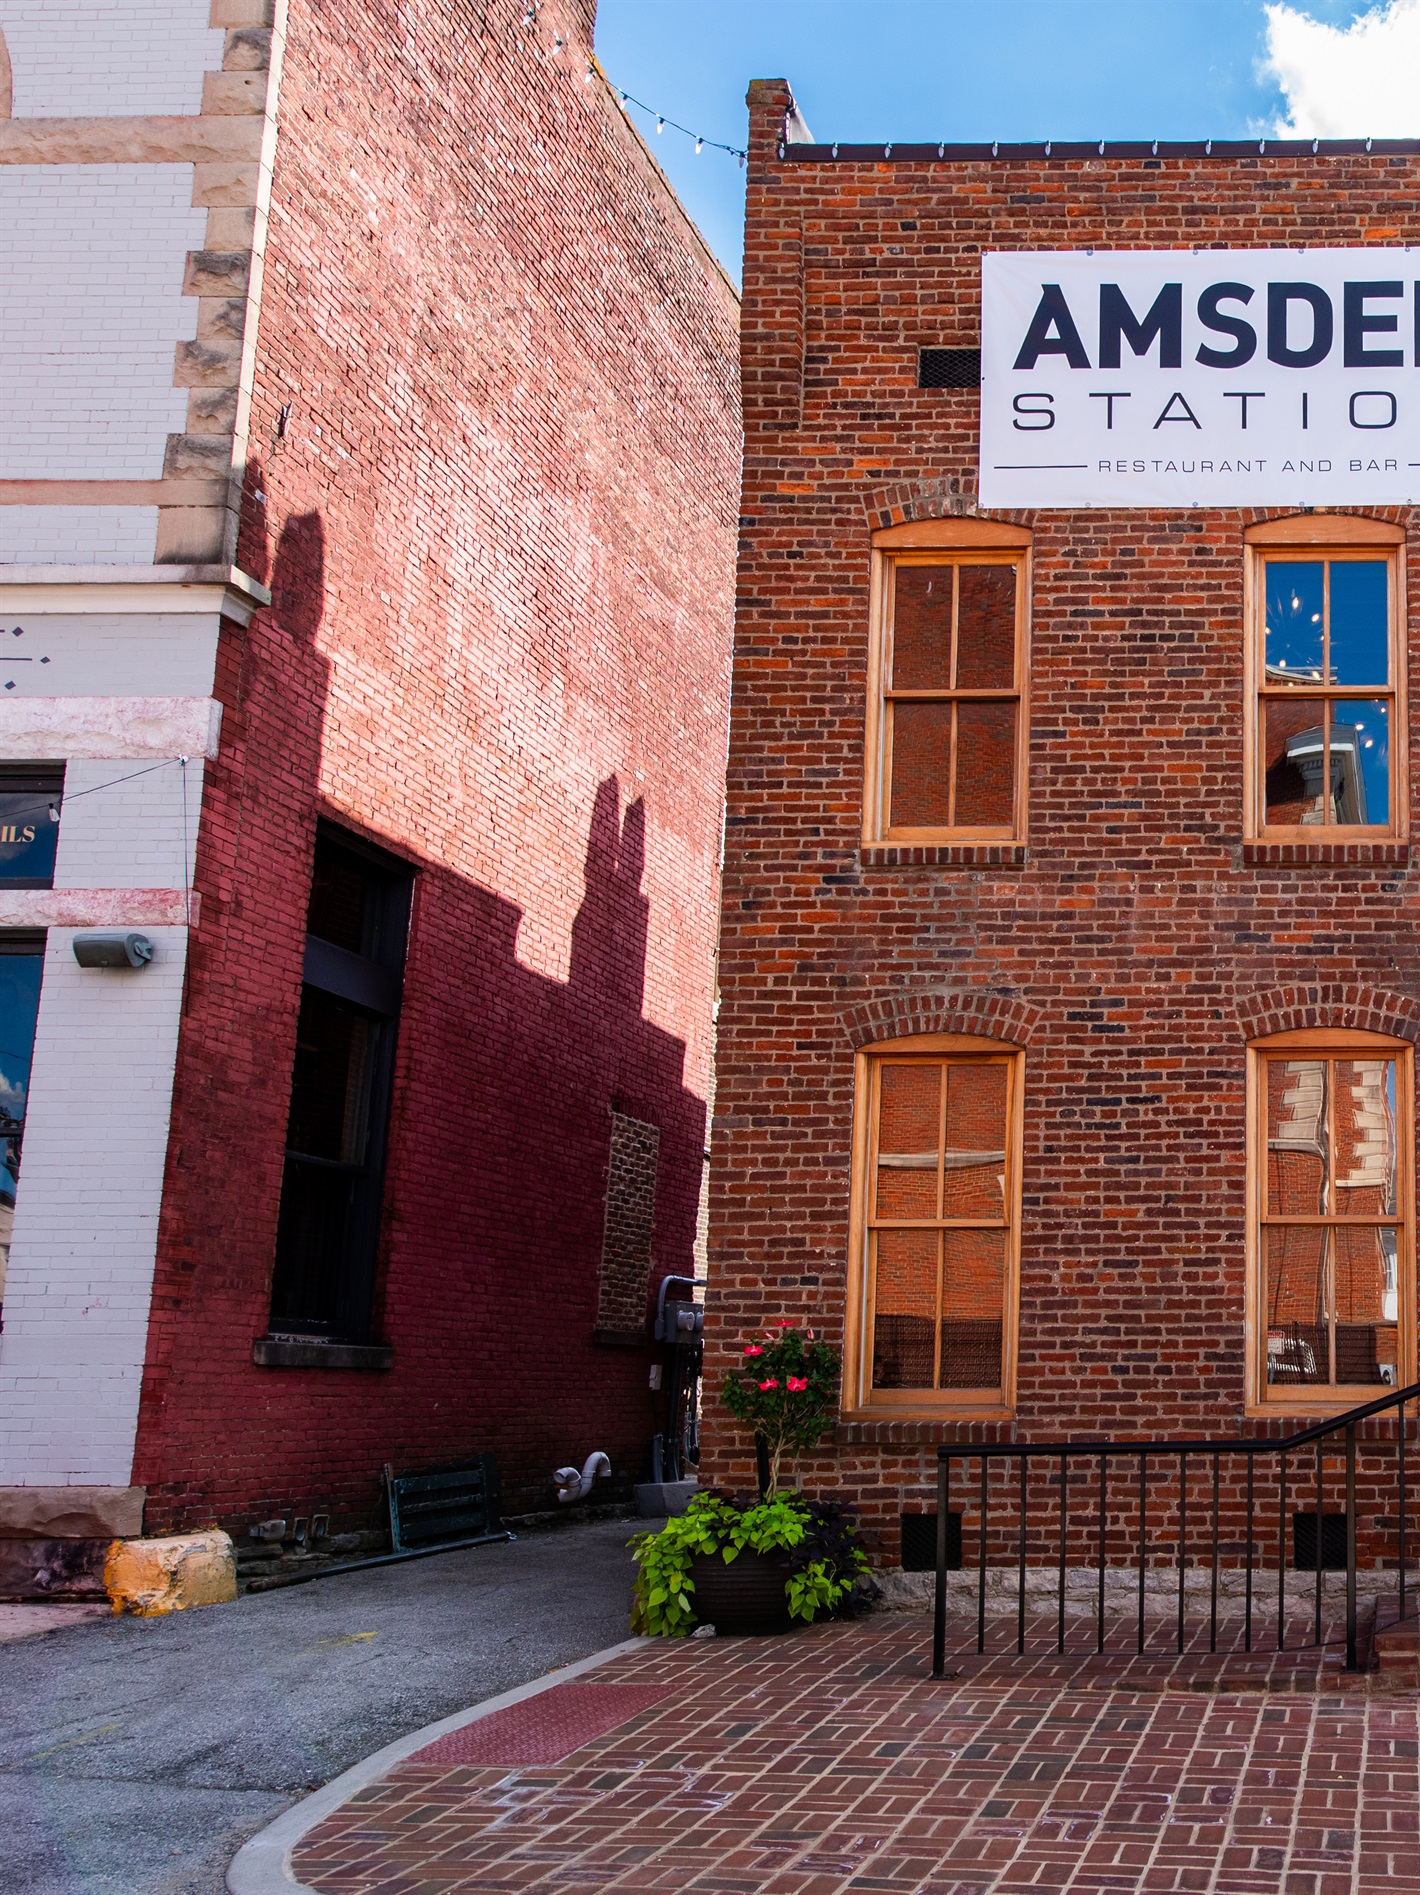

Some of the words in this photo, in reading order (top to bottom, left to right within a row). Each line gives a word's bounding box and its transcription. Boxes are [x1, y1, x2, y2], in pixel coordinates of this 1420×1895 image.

[1098, 460, 1265, 473] RESTAURANT
[1282, 459, 1332, 472] AND
[1350, 459, 1398, 472] BAR
